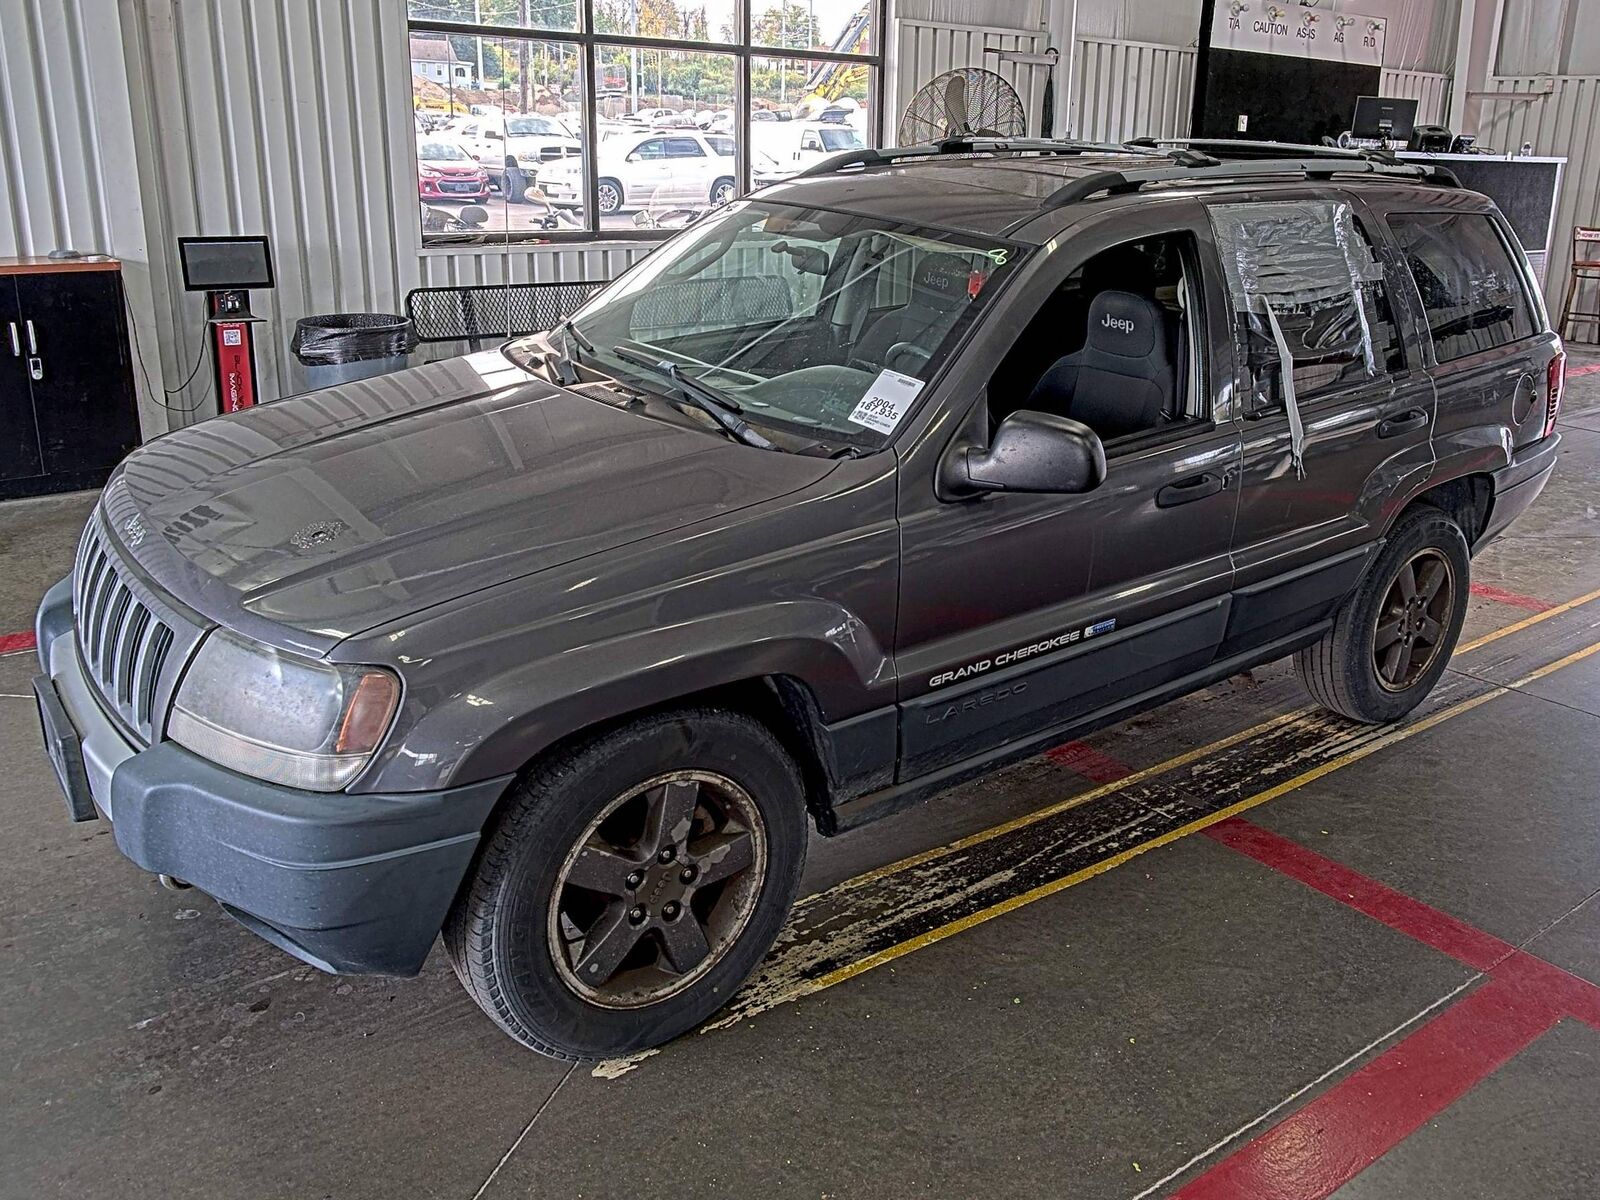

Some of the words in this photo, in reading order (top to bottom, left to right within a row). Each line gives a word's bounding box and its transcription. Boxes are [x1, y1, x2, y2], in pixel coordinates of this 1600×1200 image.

[1228, 17, 1240, 30] T/A
[1253, 20, 1288, 36] CAUTION
[1296, 27, 1316, 40] AS-IS
[1333, 32, 1344, 43] AG
[988, 248, 1008, 265] 8
[923, 271, 949, 290] Jeep
[1101, 313, 1134, 334] Jeep
[860, 401, 899, 420] 187,935
[870, 396, 896, 411] 2004
[124, 512, 147, 547] Jeep
[929, 659, 991, 687] GRAND
[995, 630, 1080, 666] CHEROKEE
[925, 681, 1028, 725] LAREDO
